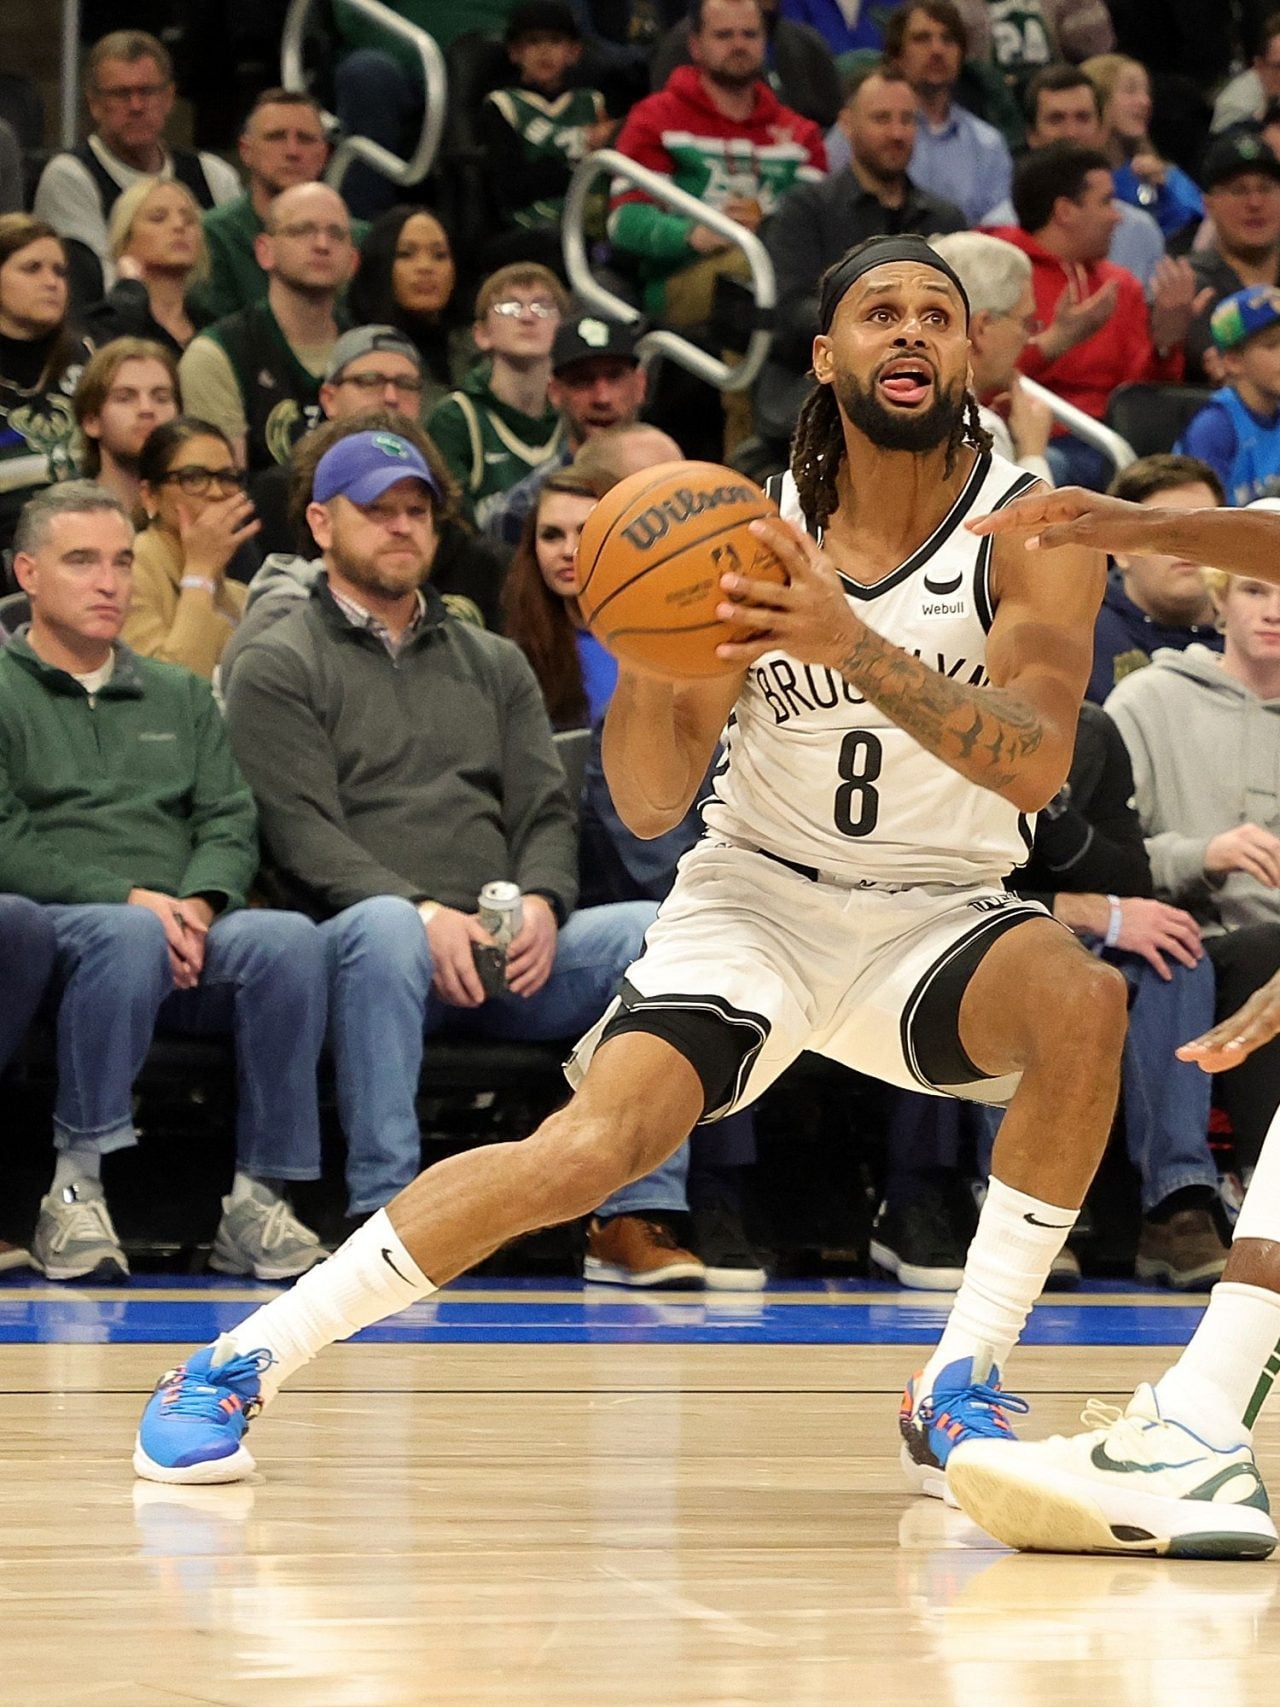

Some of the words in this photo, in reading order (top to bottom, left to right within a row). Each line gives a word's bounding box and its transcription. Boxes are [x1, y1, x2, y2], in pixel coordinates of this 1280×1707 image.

[620, 486, 757, 550] Wilson
[922, 602, 964, 616] Webull
[834, 730, 882, 837] 8
